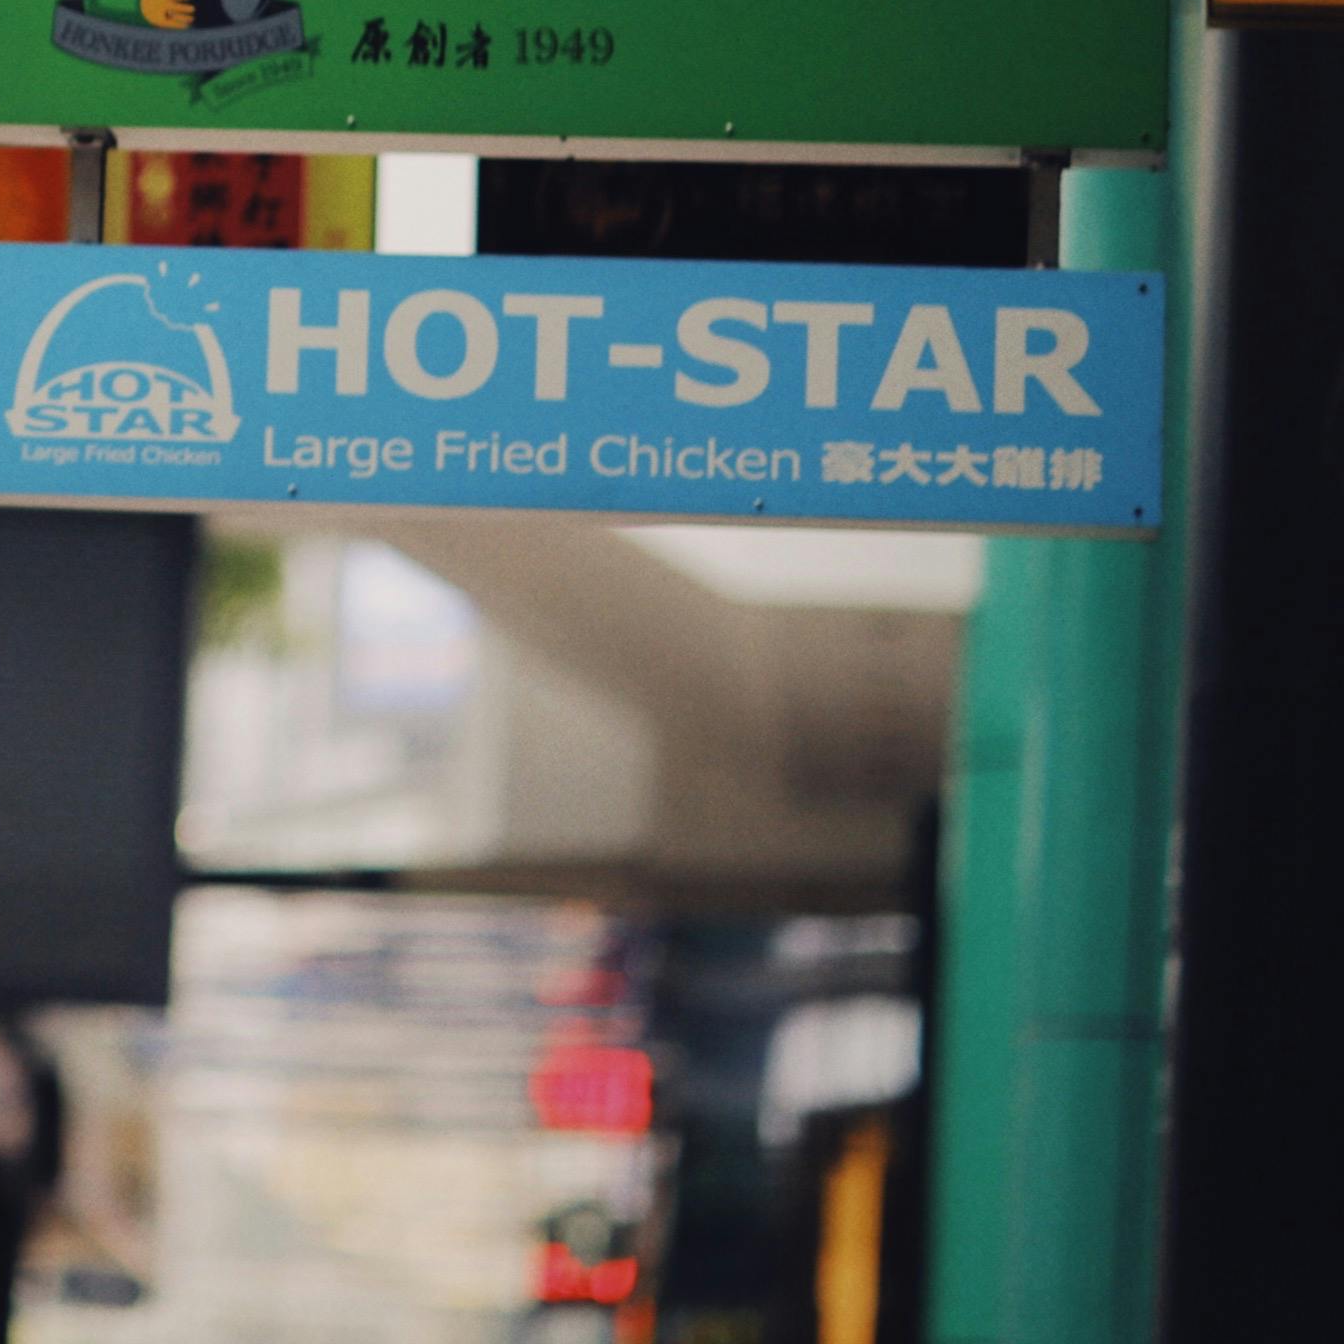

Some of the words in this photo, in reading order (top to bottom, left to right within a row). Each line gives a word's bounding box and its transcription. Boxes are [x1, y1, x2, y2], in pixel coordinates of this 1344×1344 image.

[62, 21, 162, 63] HONKEE
[168, 23, 292, 65] PORRIDGE
[515, 26, 616, 66] 1949
[264, 287, 1103, 417] HOT-STAR
[47, 368, 200, 403] HOT
[23, 404, 218, 437] STAR
[262, 425, 416, 478] Large
[435, 428, 568, 476] Fried
[589, 432, 803, 482] Chicken
